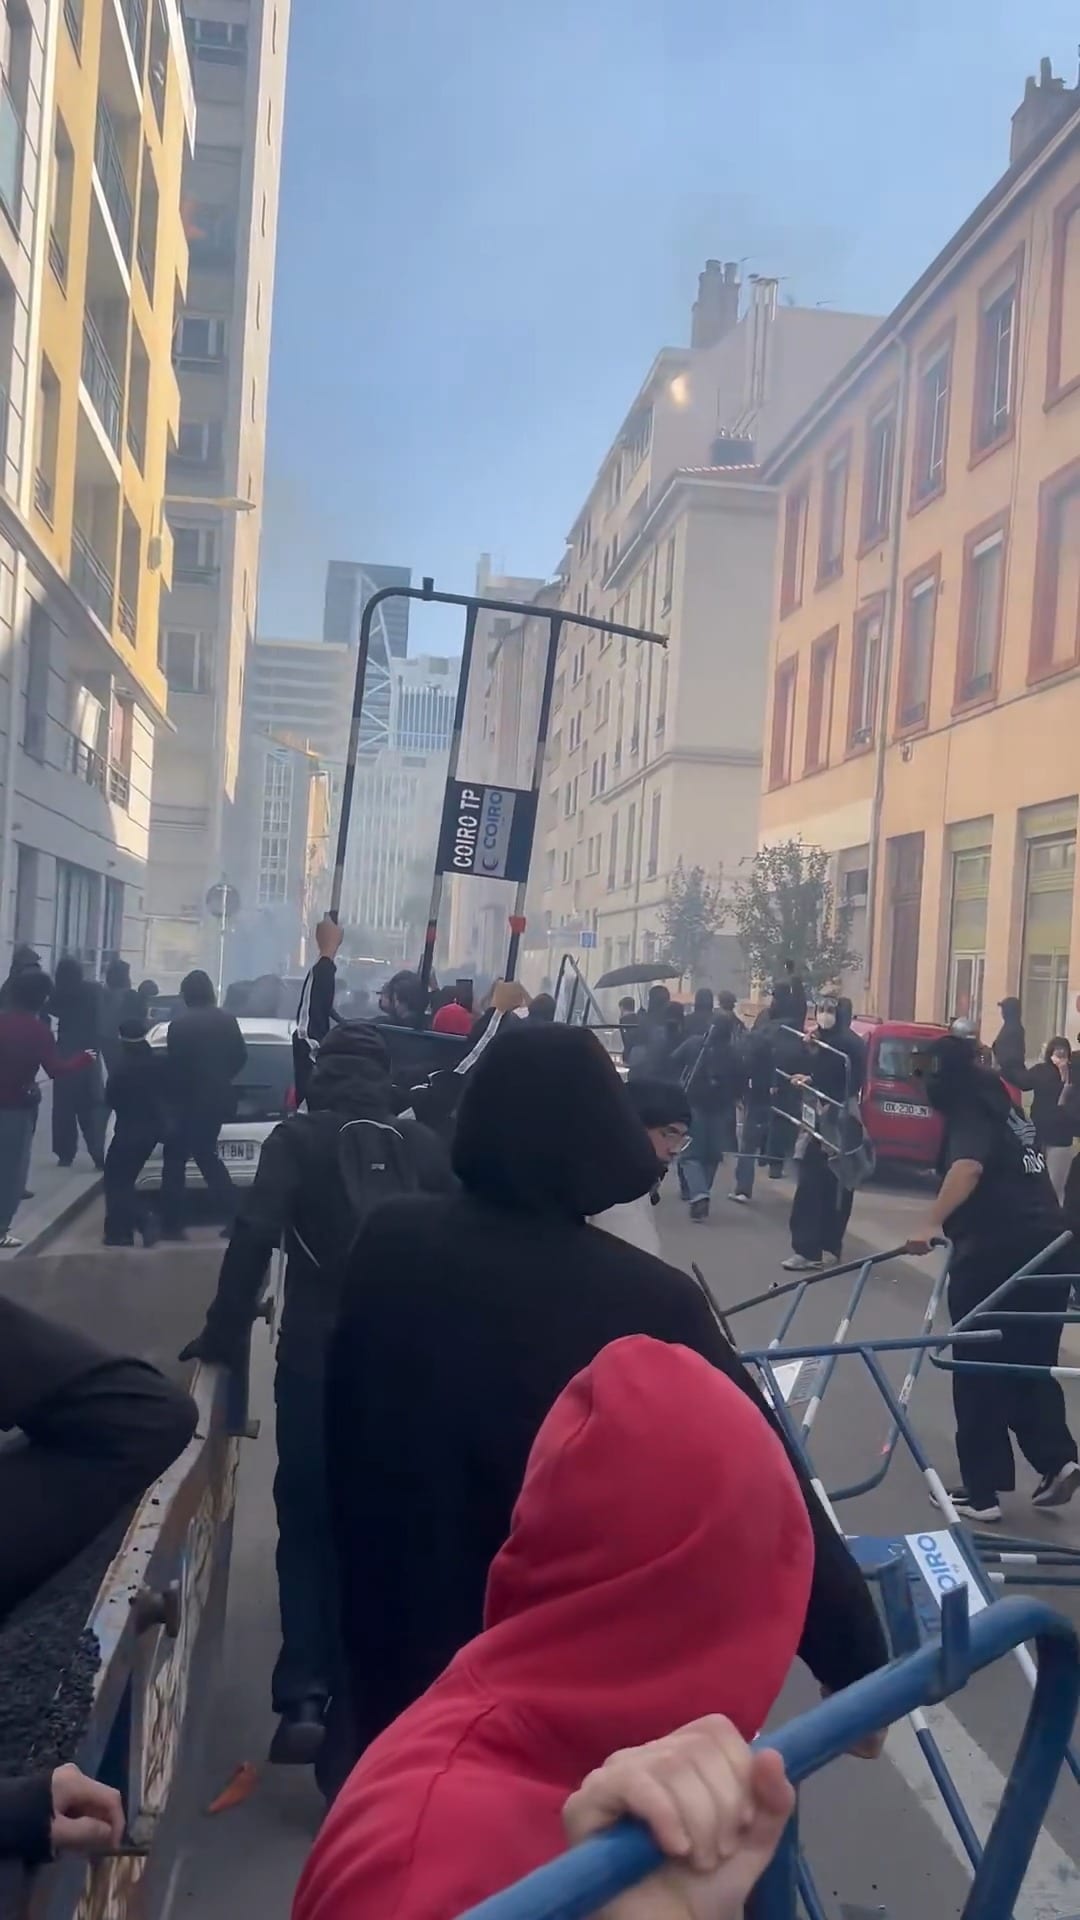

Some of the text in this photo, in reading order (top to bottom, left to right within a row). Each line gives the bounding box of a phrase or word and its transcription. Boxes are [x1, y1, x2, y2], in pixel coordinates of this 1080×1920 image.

[453, 788, 481, 868] COIRO TP
[483, 791, 503, 849] COIRO
[917, 1535, 958, 1591] OIRO
